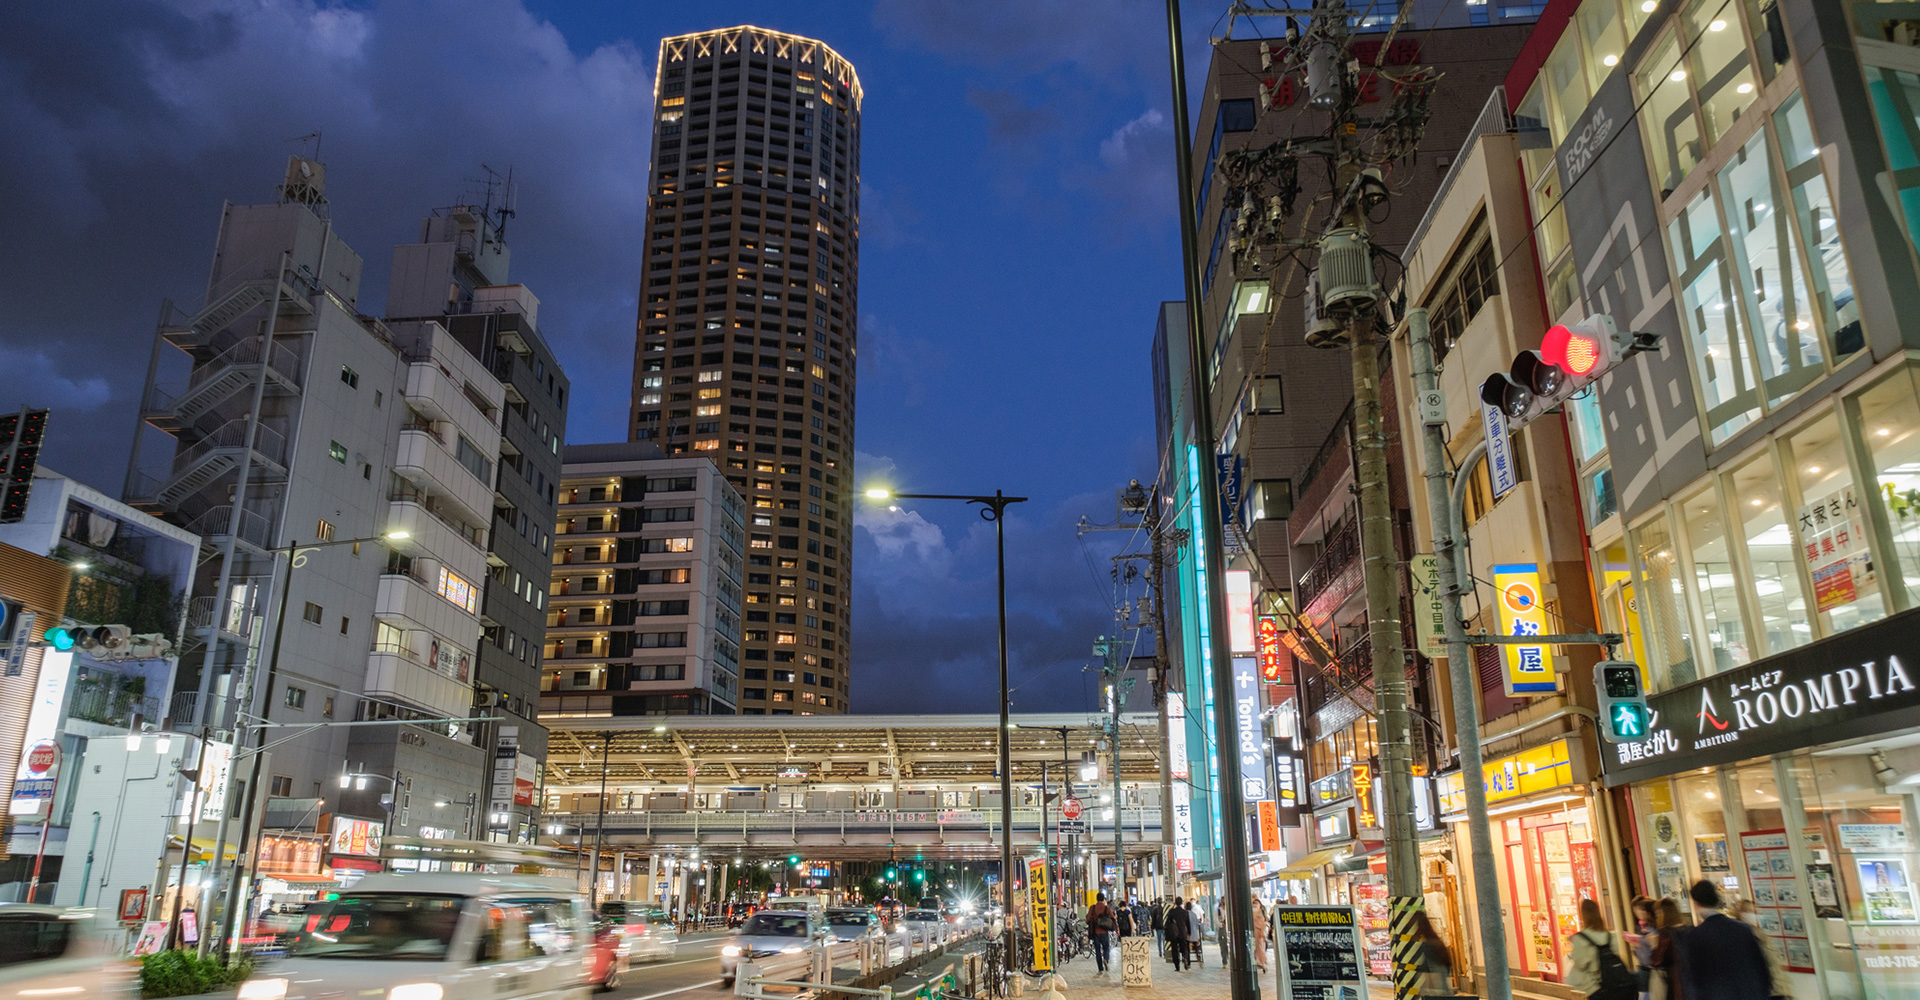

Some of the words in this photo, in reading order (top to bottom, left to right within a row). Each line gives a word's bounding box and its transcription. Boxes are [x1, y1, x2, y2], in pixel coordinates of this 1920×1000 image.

[1565, 106, 1606, 169] ROOM
[1568, 148, 1592, 184] PIA
[1488, 406, 1510, 489] 歩車分離式
[1799, 491, 1858, 532] 大家さん
[1422, 559, 1438, 567] KK
[1804, 524, 1862, 563] 募集中!
[1428, 569, 1446, 635] ホテル中目黒
[1261, 621, 1278, 677] ハンバーグ
[1510, 617, 1545, 673] 松屋
[1730, 669, 1783, 698] ルームピア
[1733, 654, 1916, 731] ROOMPIA
[1238, 696, 1262, 766] Tomod's
[1617, 729, 1679, 764] 部屋さがし
[1694, 731, 1739, 750] AMBITION
[29, 754, 53, 765] 消火栓
[1353, 765, 1375, 828] ステーキ
[1281, 911, 1304, 924] 中目黒
[1122, 939, 1149, 955] うどん
[1126, 963, 1146, 976] OK
